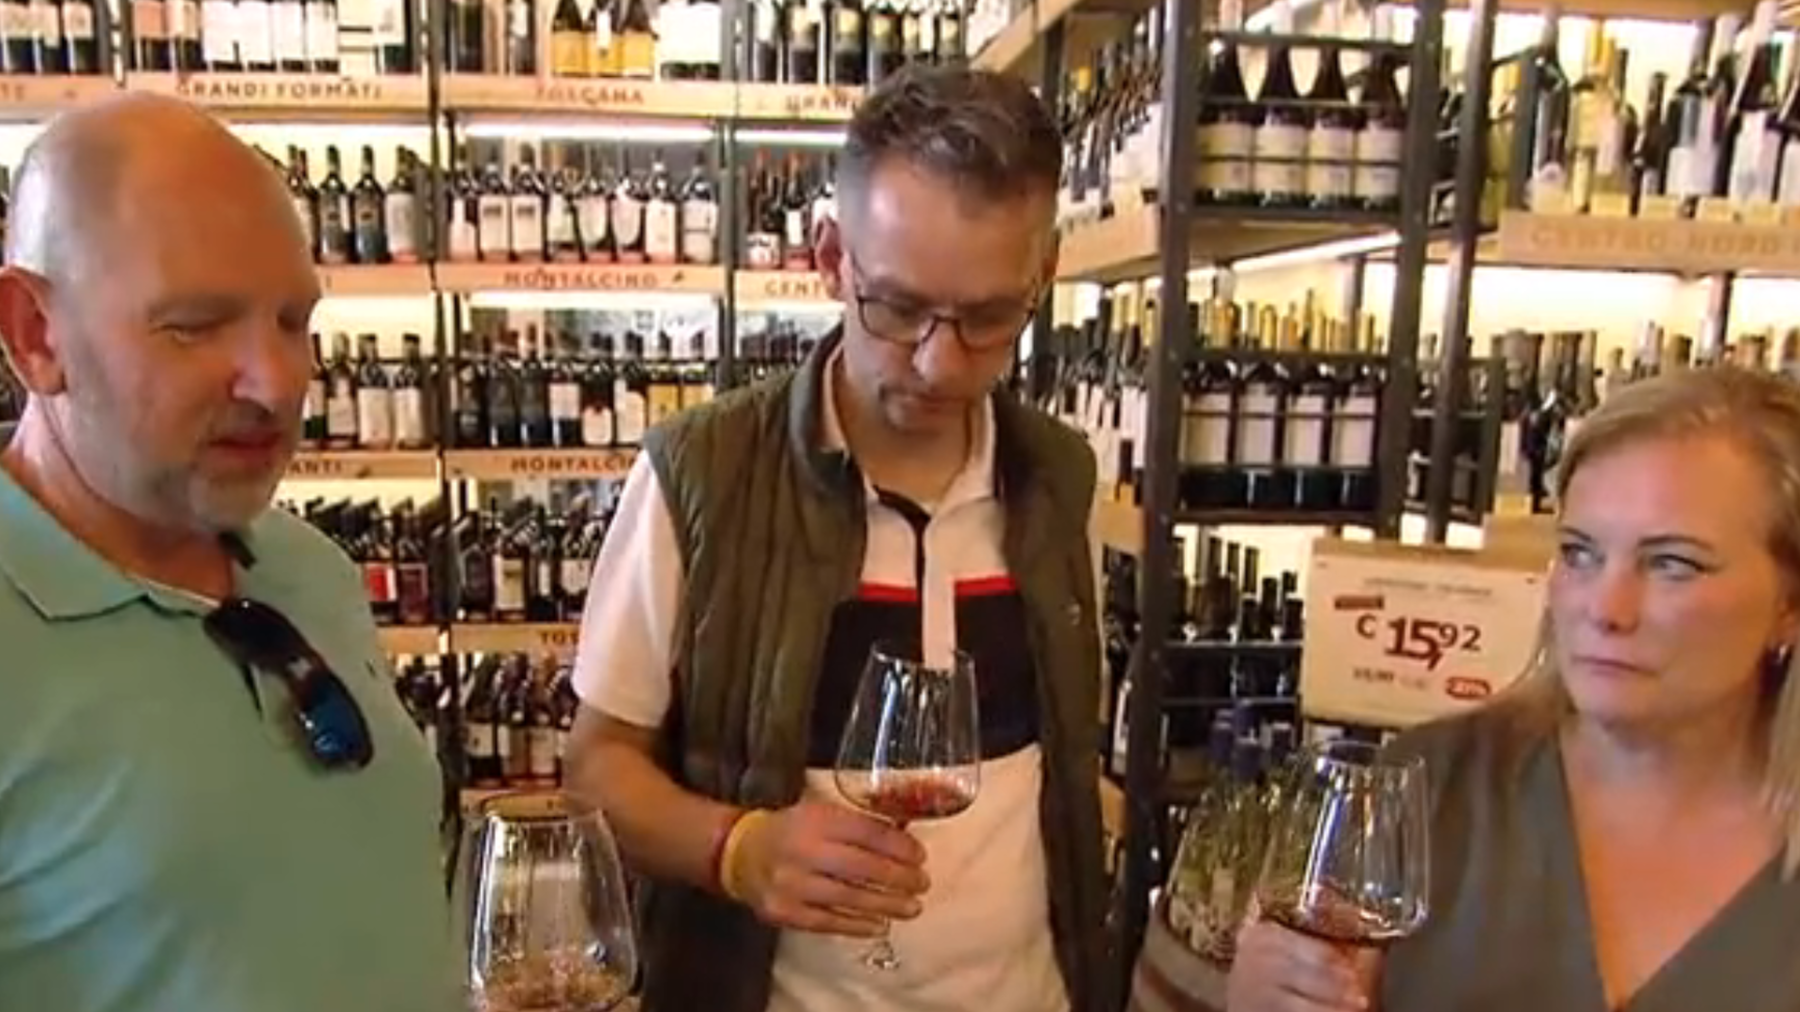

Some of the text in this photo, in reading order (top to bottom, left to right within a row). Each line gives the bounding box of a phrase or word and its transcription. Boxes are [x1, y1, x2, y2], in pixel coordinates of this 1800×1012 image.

[174, 80, 382, 99] GRANDI FORMATI
[537, 86, 644, 105] TOSCANA
[503, 270, 659, 290] MONTALCINO
